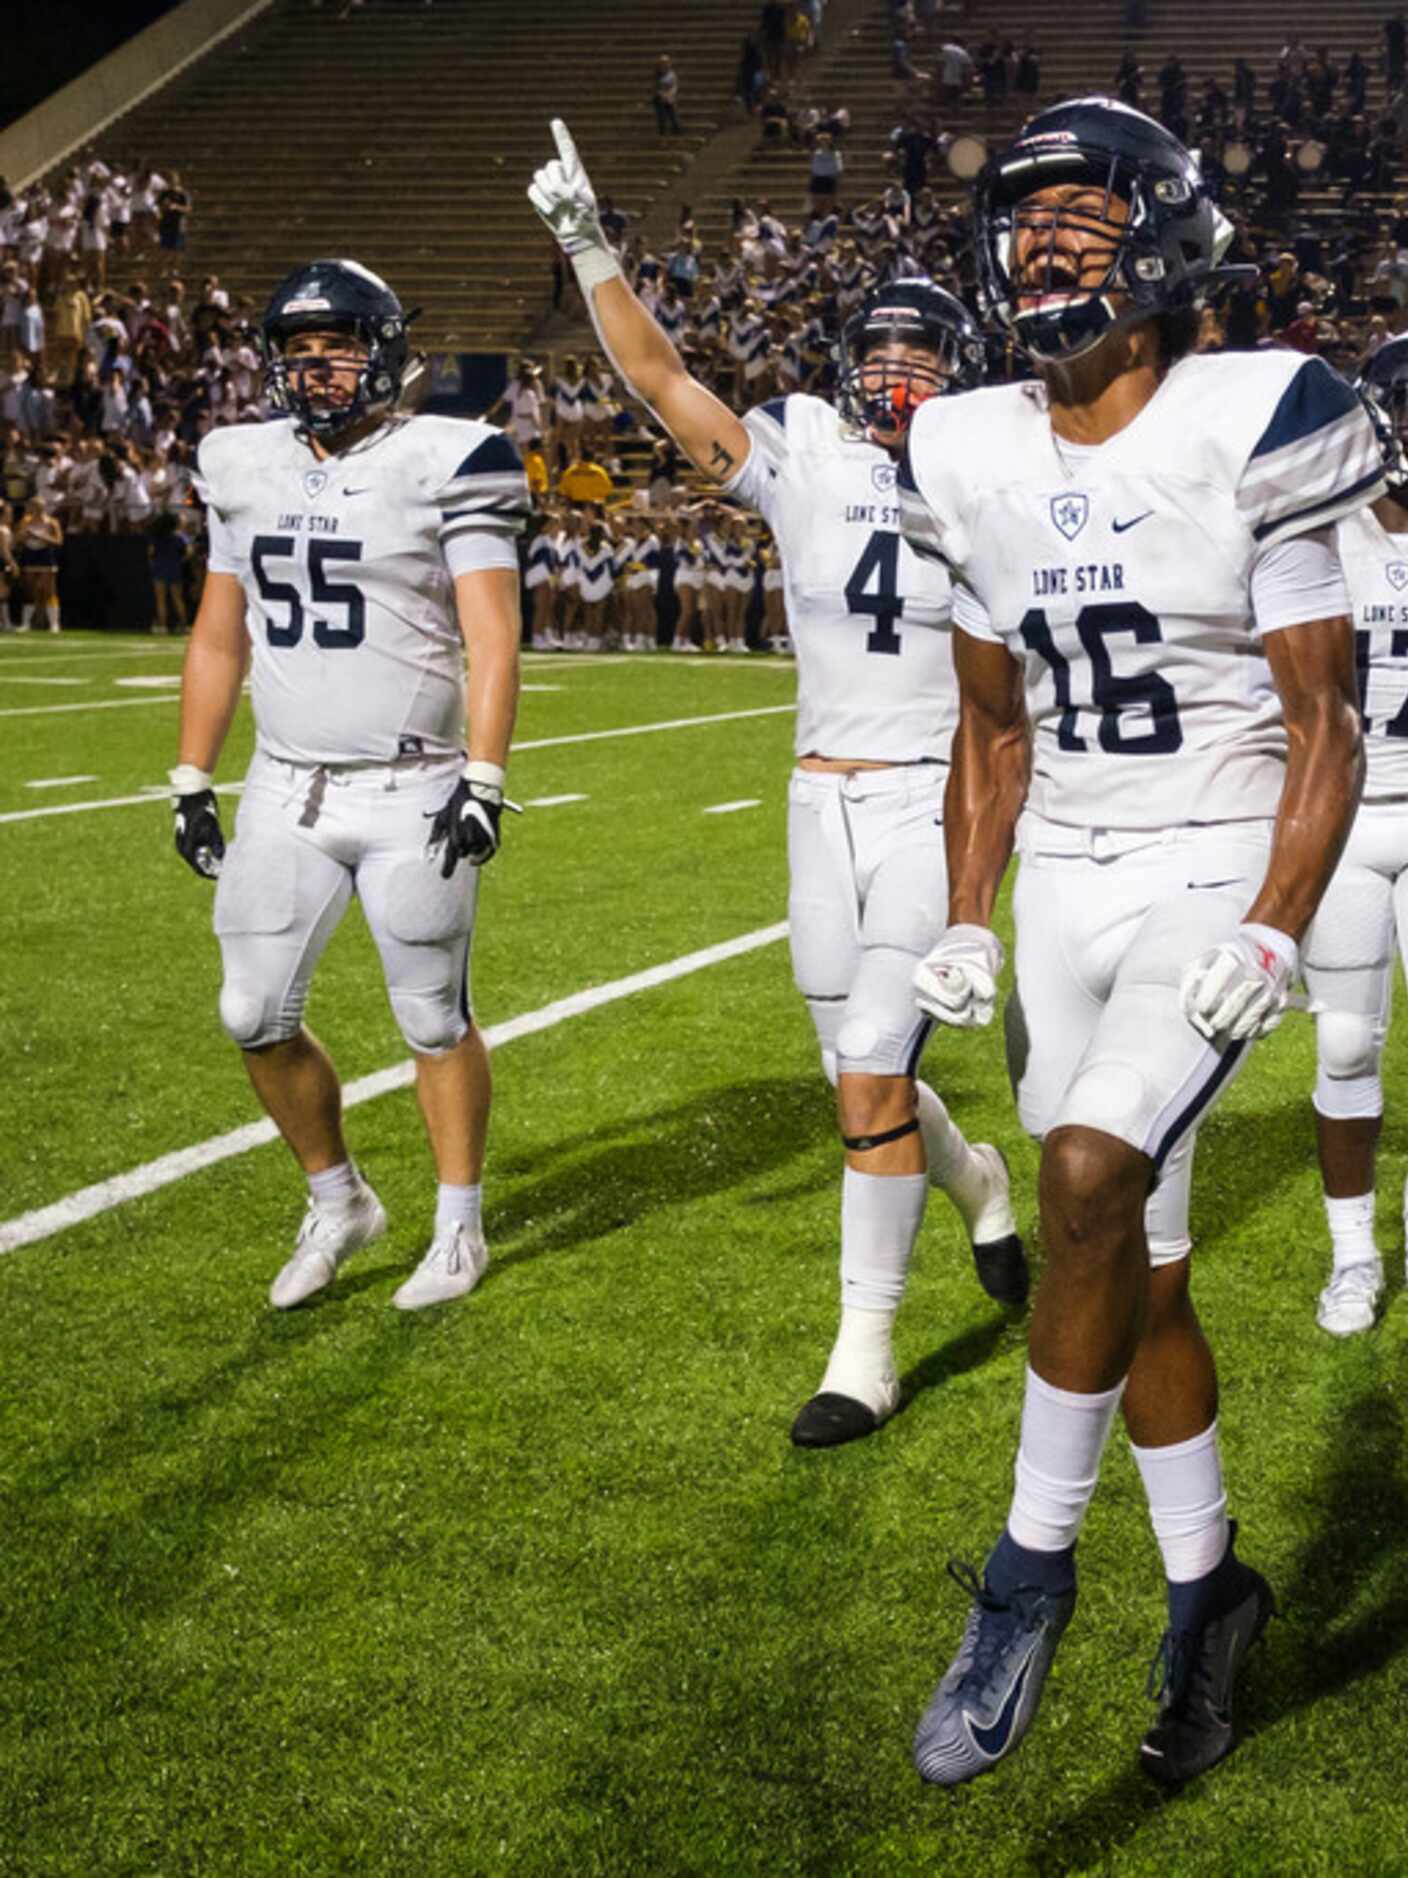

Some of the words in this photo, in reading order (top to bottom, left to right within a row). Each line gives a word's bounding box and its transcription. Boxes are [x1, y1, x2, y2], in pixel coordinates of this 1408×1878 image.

[882, 506, 900, 525] ST
[250, 535, 366, 649] 55
[844, 530, 905, 656] 4
[1033, 568, 1068, 596] LONE
[1075, 563, 1124, 592] STAR
[1363, 605, 1395, 622] LONE
[1018, 600, 1183, 755] 16
